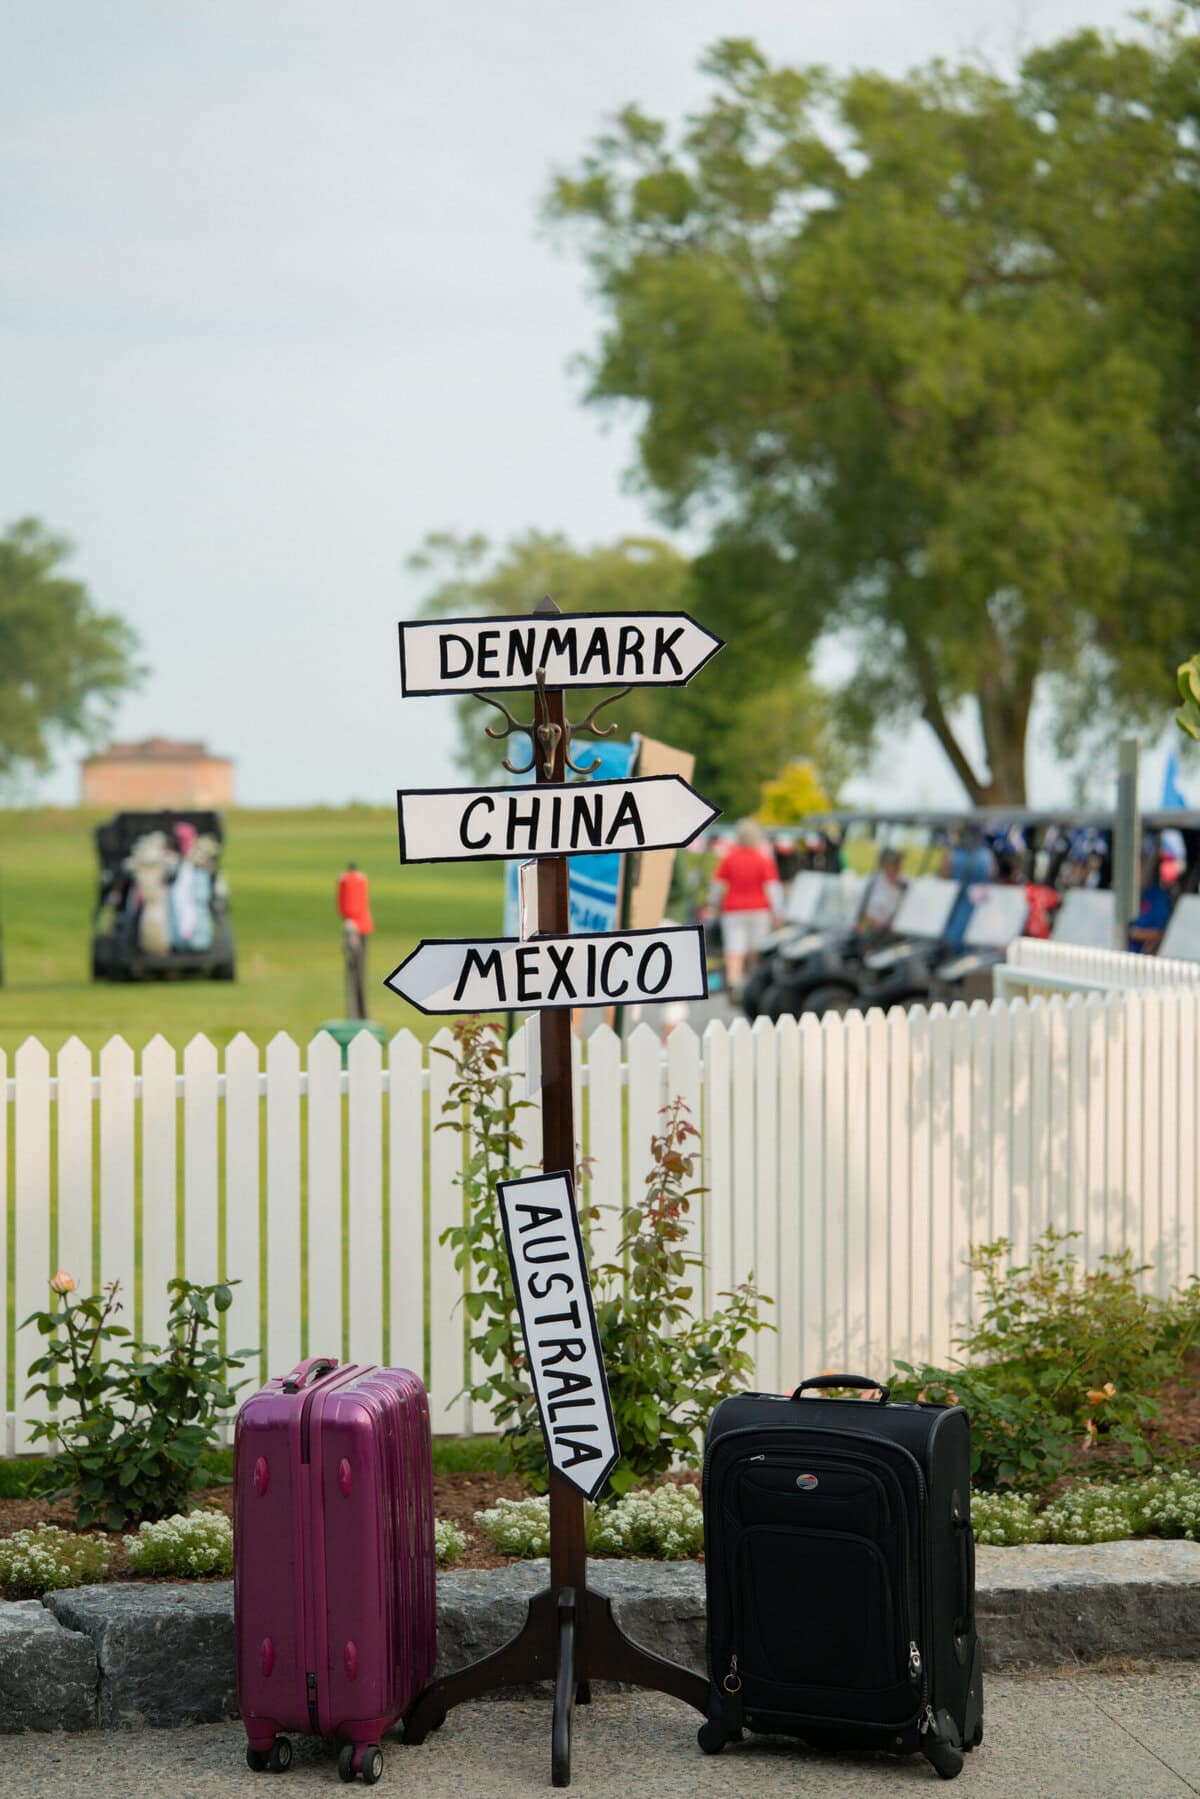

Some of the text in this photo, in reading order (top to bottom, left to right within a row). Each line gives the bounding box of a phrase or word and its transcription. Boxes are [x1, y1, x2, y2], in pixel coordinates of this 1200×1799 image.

[439, 625, 685, 679] DENMARK
[459, 791, 646, 850] CHINA
[453, 941, 673, 1002] MEXICO
[515, 1203, 603, 1469] AUSTRALIA
